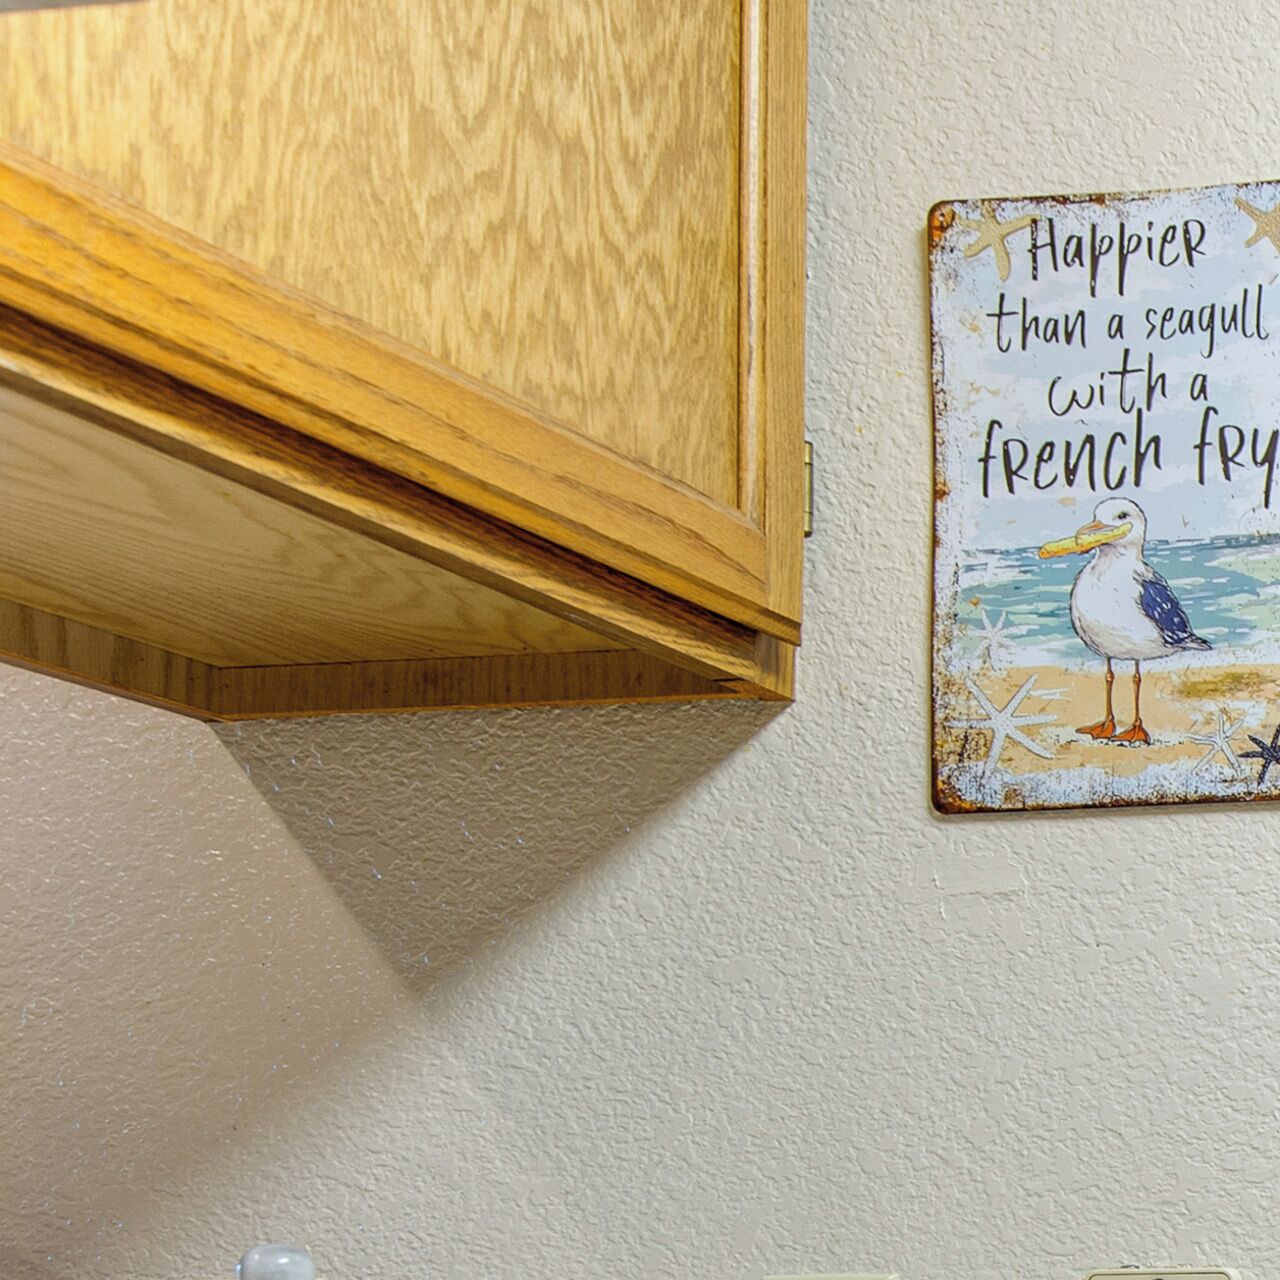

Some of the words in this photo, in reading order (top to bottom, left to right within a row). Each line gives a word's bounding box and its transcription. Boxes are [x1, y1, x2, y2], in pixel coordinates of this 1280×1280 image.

[986, 293, 1086, 352] than
[1107, 310, 1124, 339] a
[1145, 284, 1269, 358] seagull
[1048, 348, 1167, 416] with
[1190, 373, 1208, 401] a
